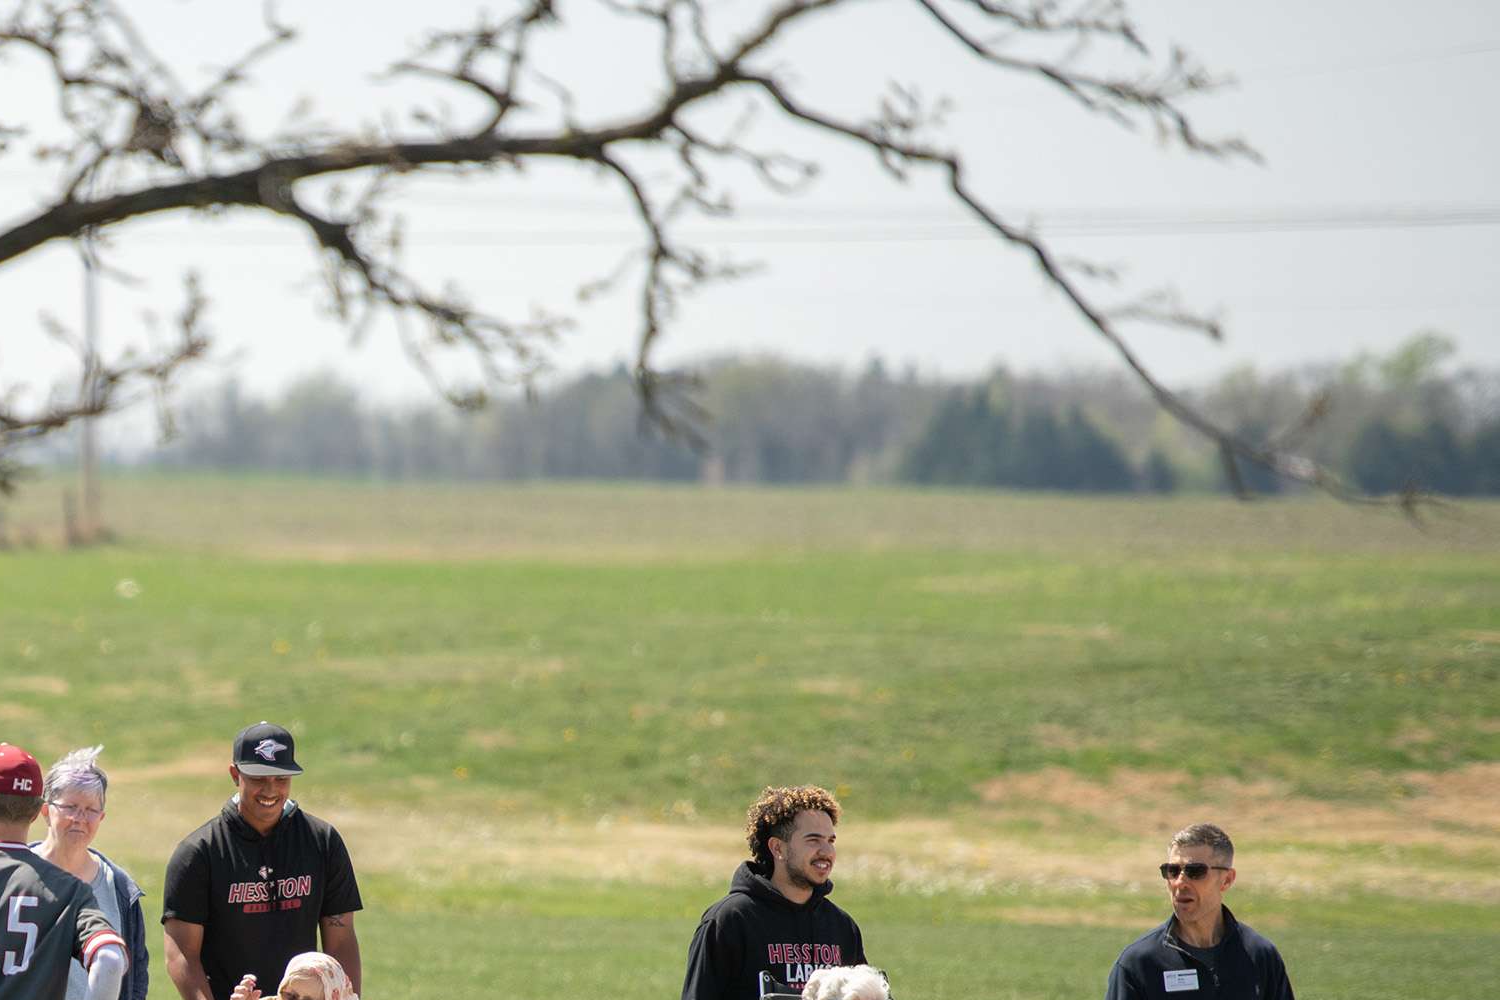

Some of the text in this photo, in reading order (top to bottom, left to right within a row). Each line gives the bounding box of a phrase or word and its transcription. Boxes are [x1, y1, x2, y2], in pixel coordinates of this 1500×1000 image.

[13, 777, 33, 792] HC
[767, 943, 842, 965] HESSTON
[785, 963, 832, 983] LAR
